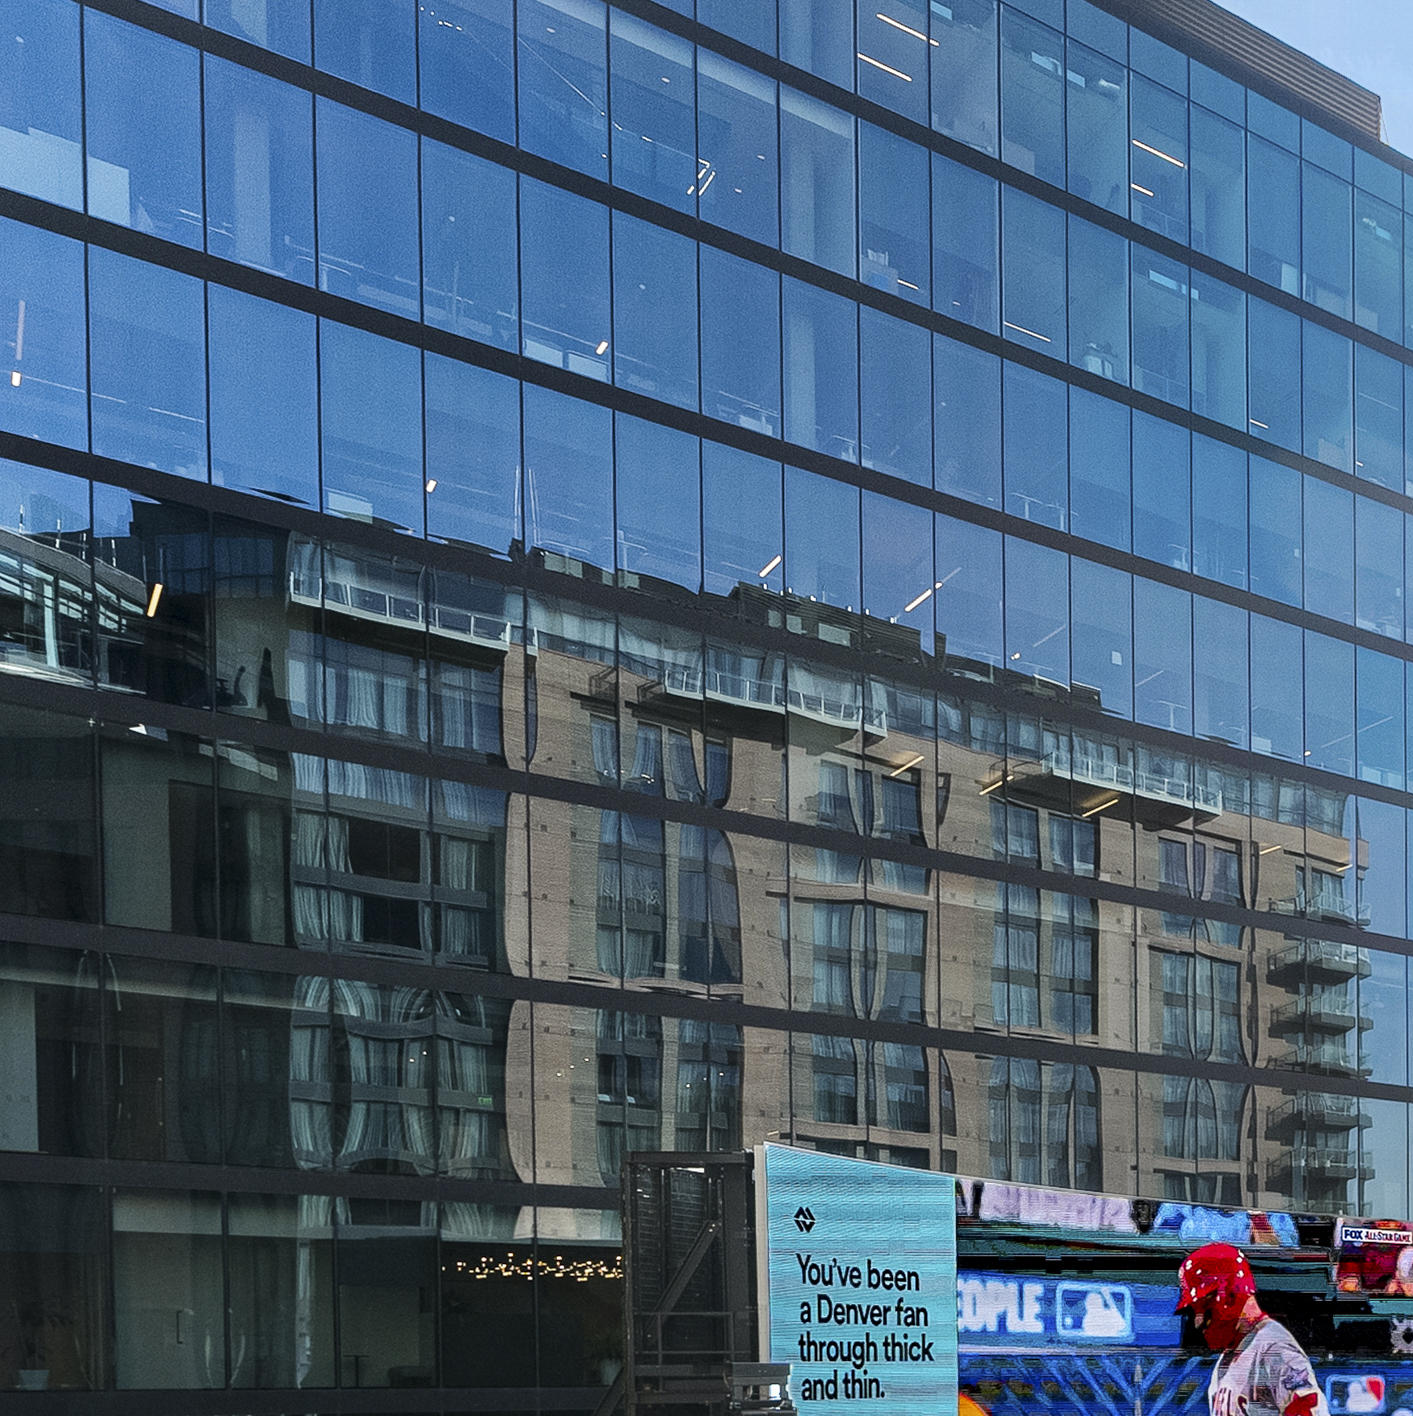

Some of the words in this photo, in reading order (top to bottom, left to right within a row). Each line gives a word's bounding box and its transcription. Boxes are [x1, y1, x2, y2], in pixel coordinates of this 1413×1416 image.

[1344, 1229, 1363, 1240] FOX
[796, 1253, 862, 1289] You've
[867, 1259, 920, 1291] been
[801, 1301, 812, 1324] a
[817, 1294, 891, 1326] Denver
[895, 1298, 928, 1327] fan
[798, 1331, 878, 1369] through
[883, 1333, 934, 1362] thick
[801, 1369, 838, 1401] and
[843, 1369, 886, 1399] thin.
